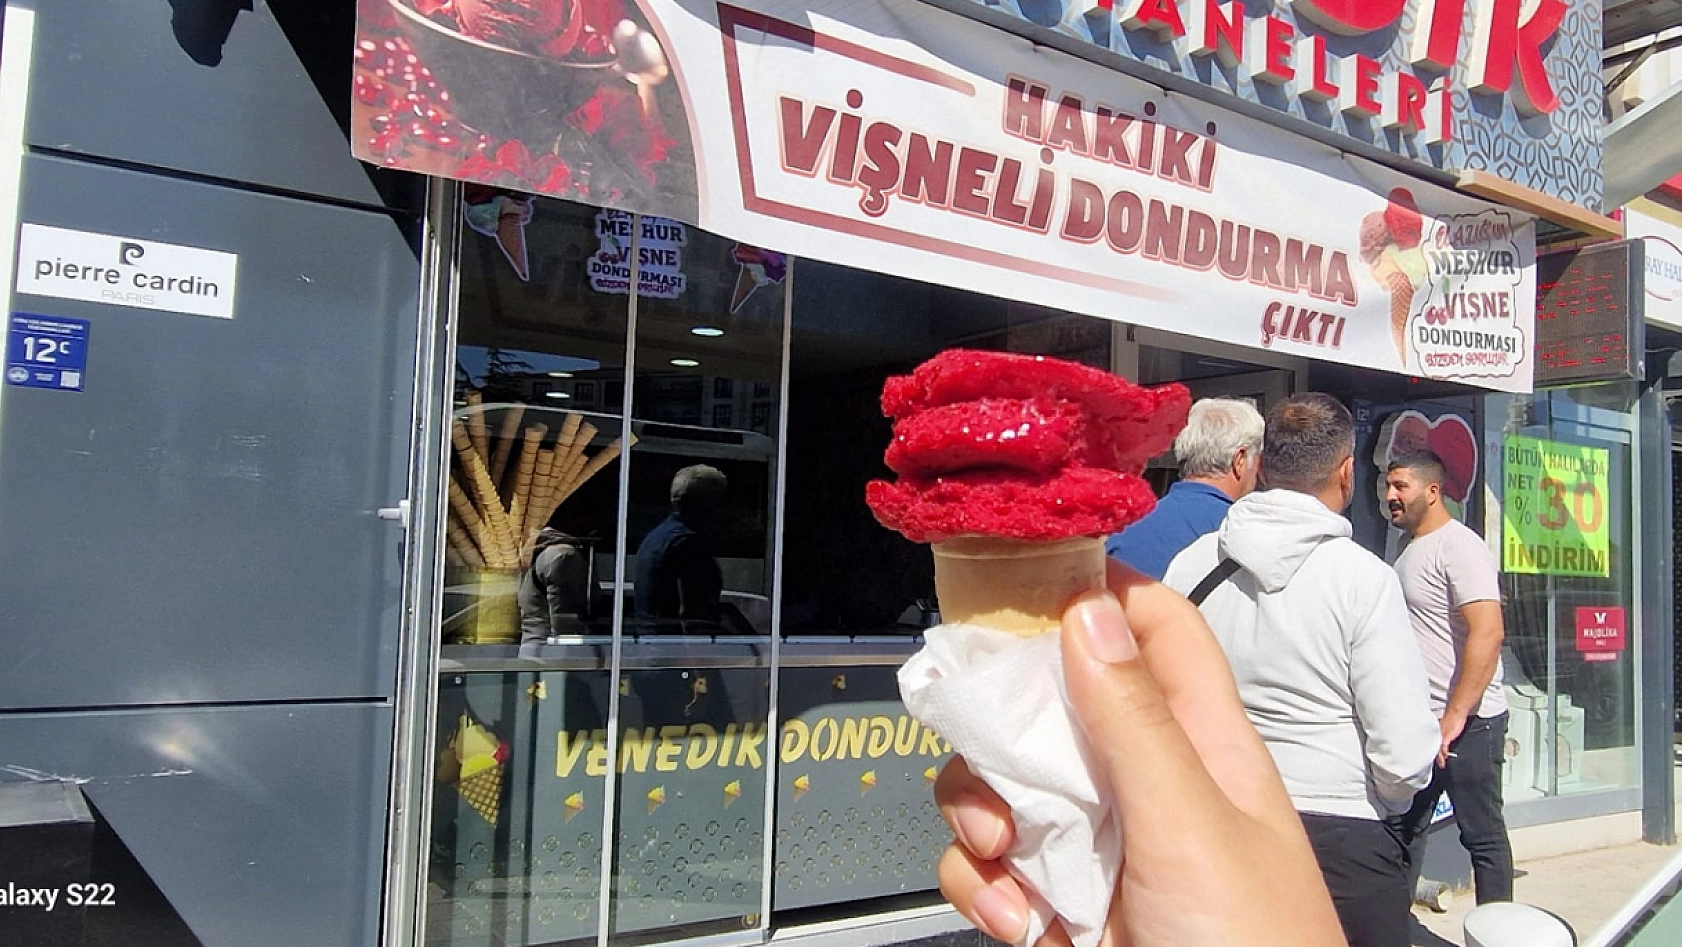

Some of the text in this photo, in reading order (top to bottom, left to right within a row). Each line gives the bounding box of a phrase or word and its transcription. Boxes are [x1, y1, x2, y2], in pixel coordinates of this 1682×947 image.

[1090, 0, 1452, 143] ANELERİ
[1003, 76, 1217, 193] HAKİKİ
[778, 88, 1358, 306] VİŞNELİ DONDURMA
[600, 219, 682, 241] MEHUR
[34, 257, 219, 298] pierre cardin
[592, 262, 682, 288] DONDRMASI
[1428, 250, 1515, 281] MEŞHUR
[100, 289, 156, 305] PARIS
[1444, 283, 1510, 322] VİŞNE
[1262, 301, 1346, 348] ÇIKTI
[1418, 326, 1516, 353] DONDURMASI
[1507, 473, 1534, 490] NET
[1536, 477, 1603, 534] 30
[1508, 537, 1606, 573] İNDİRİM
[556, 713, 952, 778] VENEDIK DONDUR
